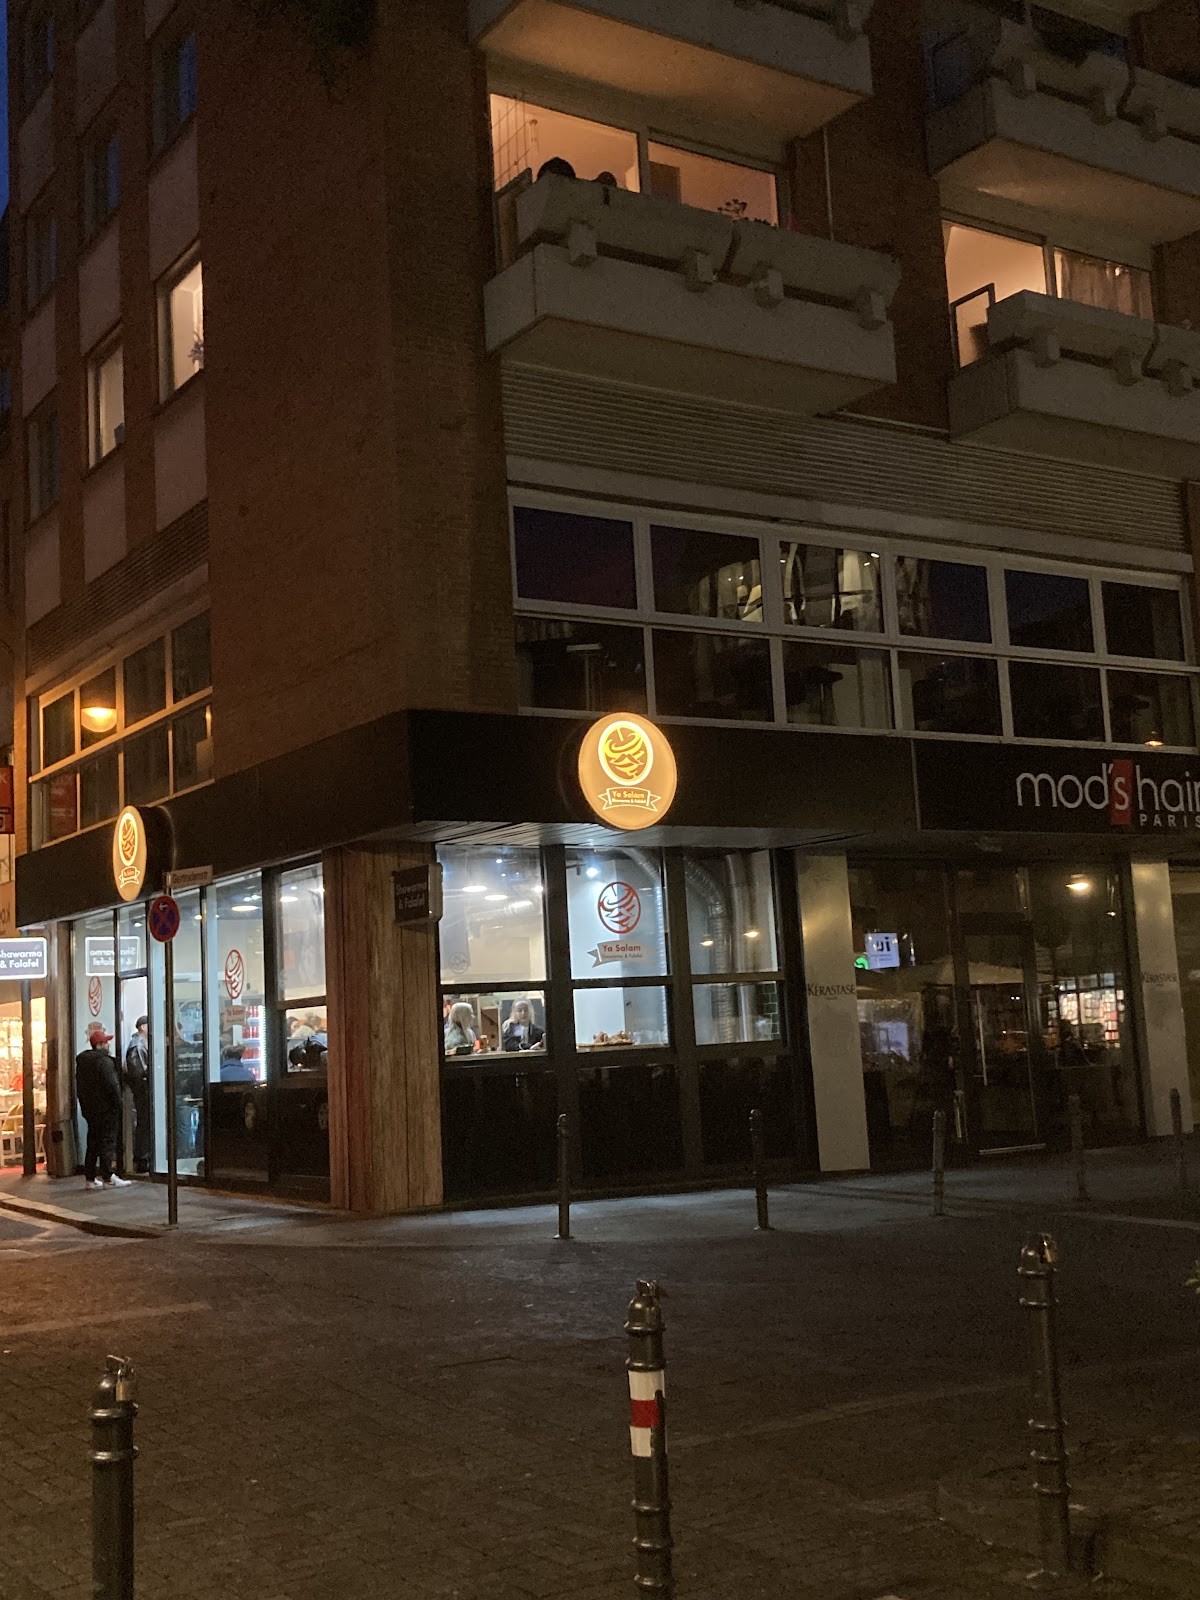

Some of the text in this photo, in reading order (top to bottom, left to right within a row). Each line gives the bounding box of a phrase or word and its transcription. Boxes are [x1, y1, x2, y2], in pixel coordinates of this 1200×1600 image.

[612, 790, 645, 799] Ya Salam
[1139, 813, 1200, 828] PARIS
[602, 943, 641, 952] Ya Salam
[0, 959, 40, 968] & Falafel
